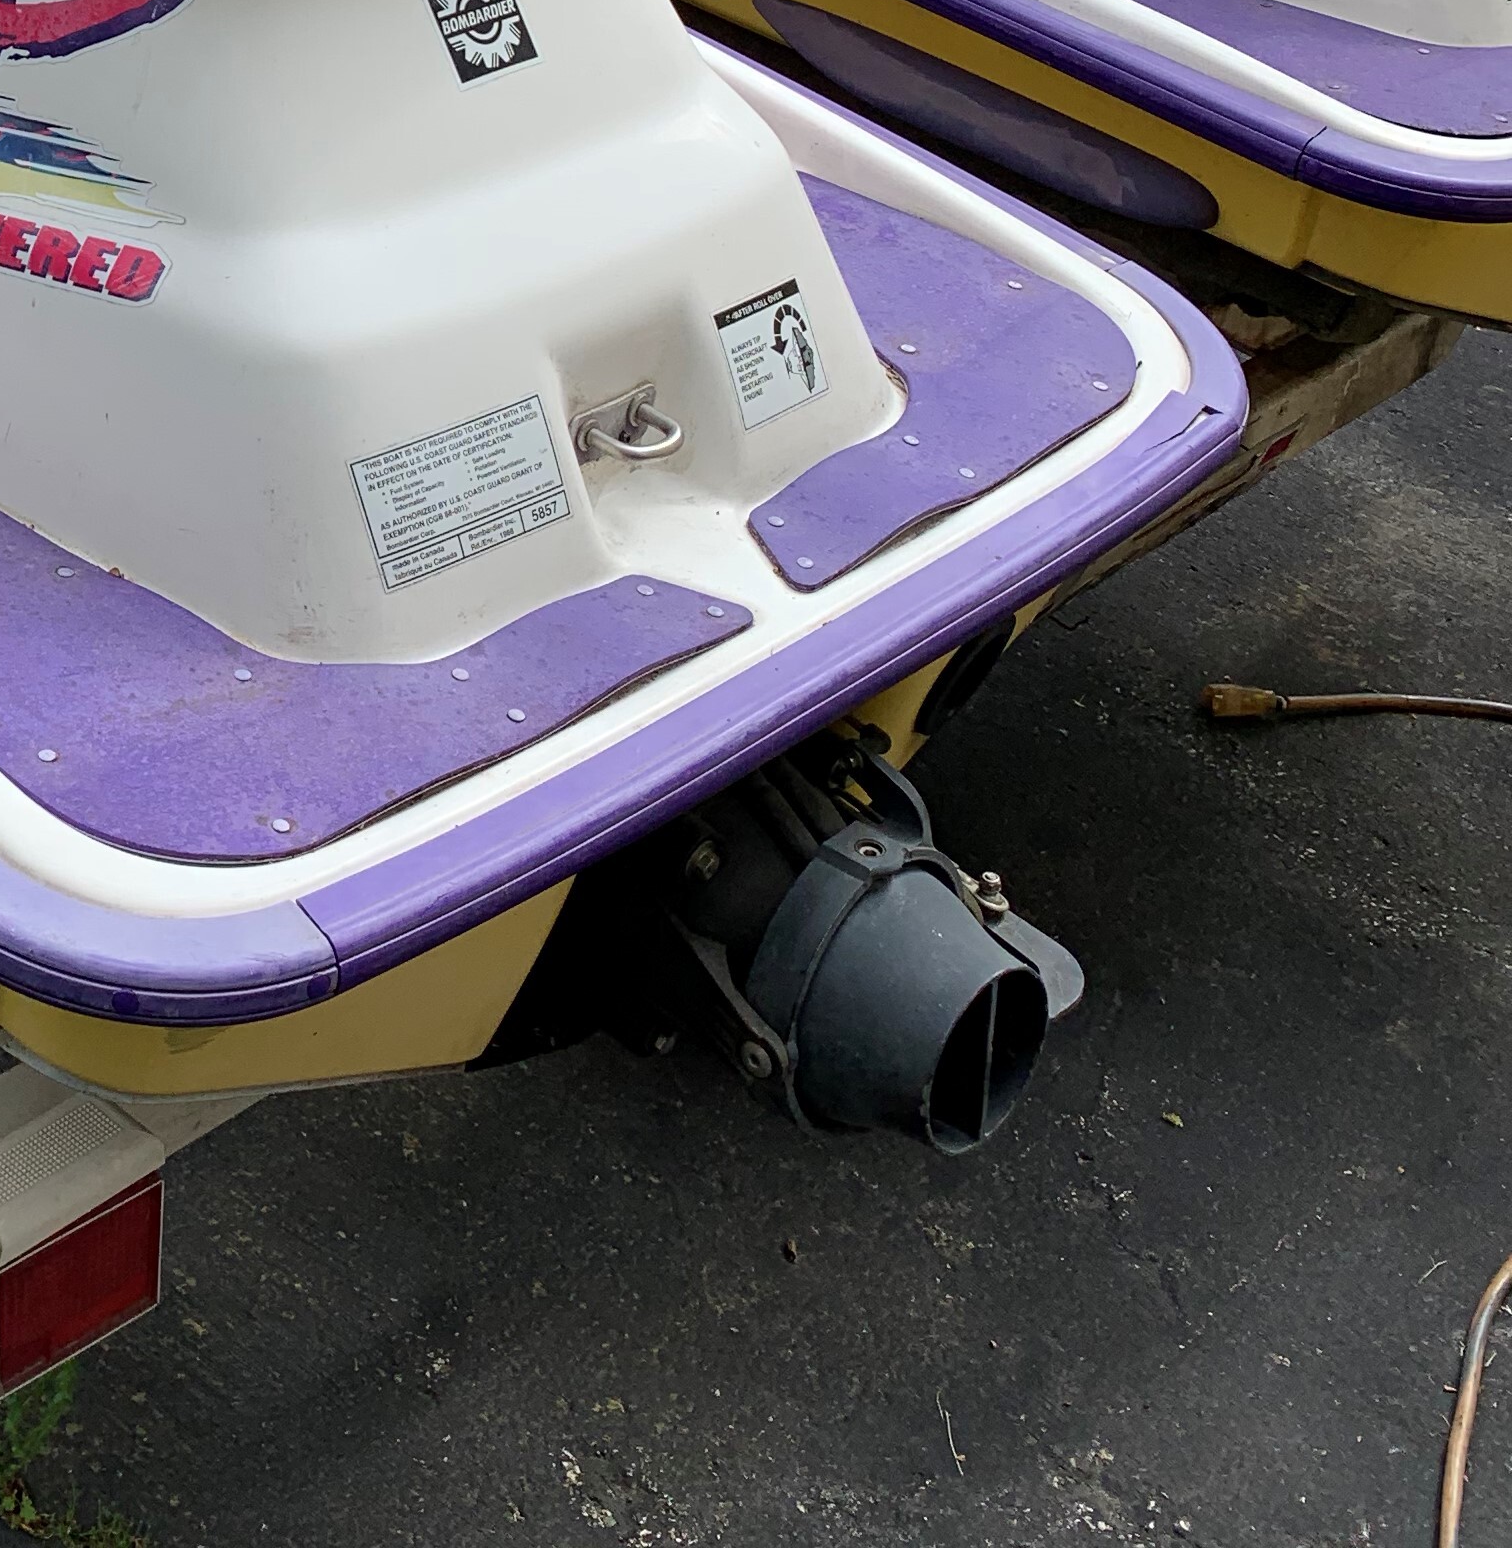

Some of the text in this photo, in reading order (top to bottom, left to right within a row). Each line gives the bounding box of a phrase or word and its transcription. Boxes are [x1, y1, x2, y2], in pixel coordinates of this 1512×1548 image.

[382, 451, 402, 464] BOAT
[412, 442, 426, 452] NOT
[428, 429, 462, 447] REQUIRED
[463, 425, 473, 433] TO
[474, 414, 500, 430] COMPLY
[502, 408, 518, 418] WITH
[518, 402, 531, 411] THE
[364, 460, 408, 481] FOLLOWING
[423, 445, 446, 460] COAST
[448, 436, 472, 450] GUARD
[473, 426, 497, 441] SAFETY
[499, 411, 537, 431] STANDARDS
[376, 472, 404, 488] EFFECT
[405, 469, 417, 478] ON
[417, 463, 432, 473] THE
[432, 455, 451, 468] DATE
[451, 451, 460, 460] OF
[380, 521, 391, 530] AS
[392, 504, 437, 526] AUTHORIZED
[437, 500, 447, 509] BY
[463, 484, 485, 499] COAST
[486, 475, 510, 489] GUARD
[511, 465, 532, 479] GRANT
[533, 461, 542, 470] OF
[531, 500, 556, 521] 5857
[383, 520, 424, 541] EXEMPTION
[468, 522, 503, 540] Bombardier
[392, 559, 410, 569] made
[419, 546, 444, 559] Canada
[433, 551, 457, 565] Canada
